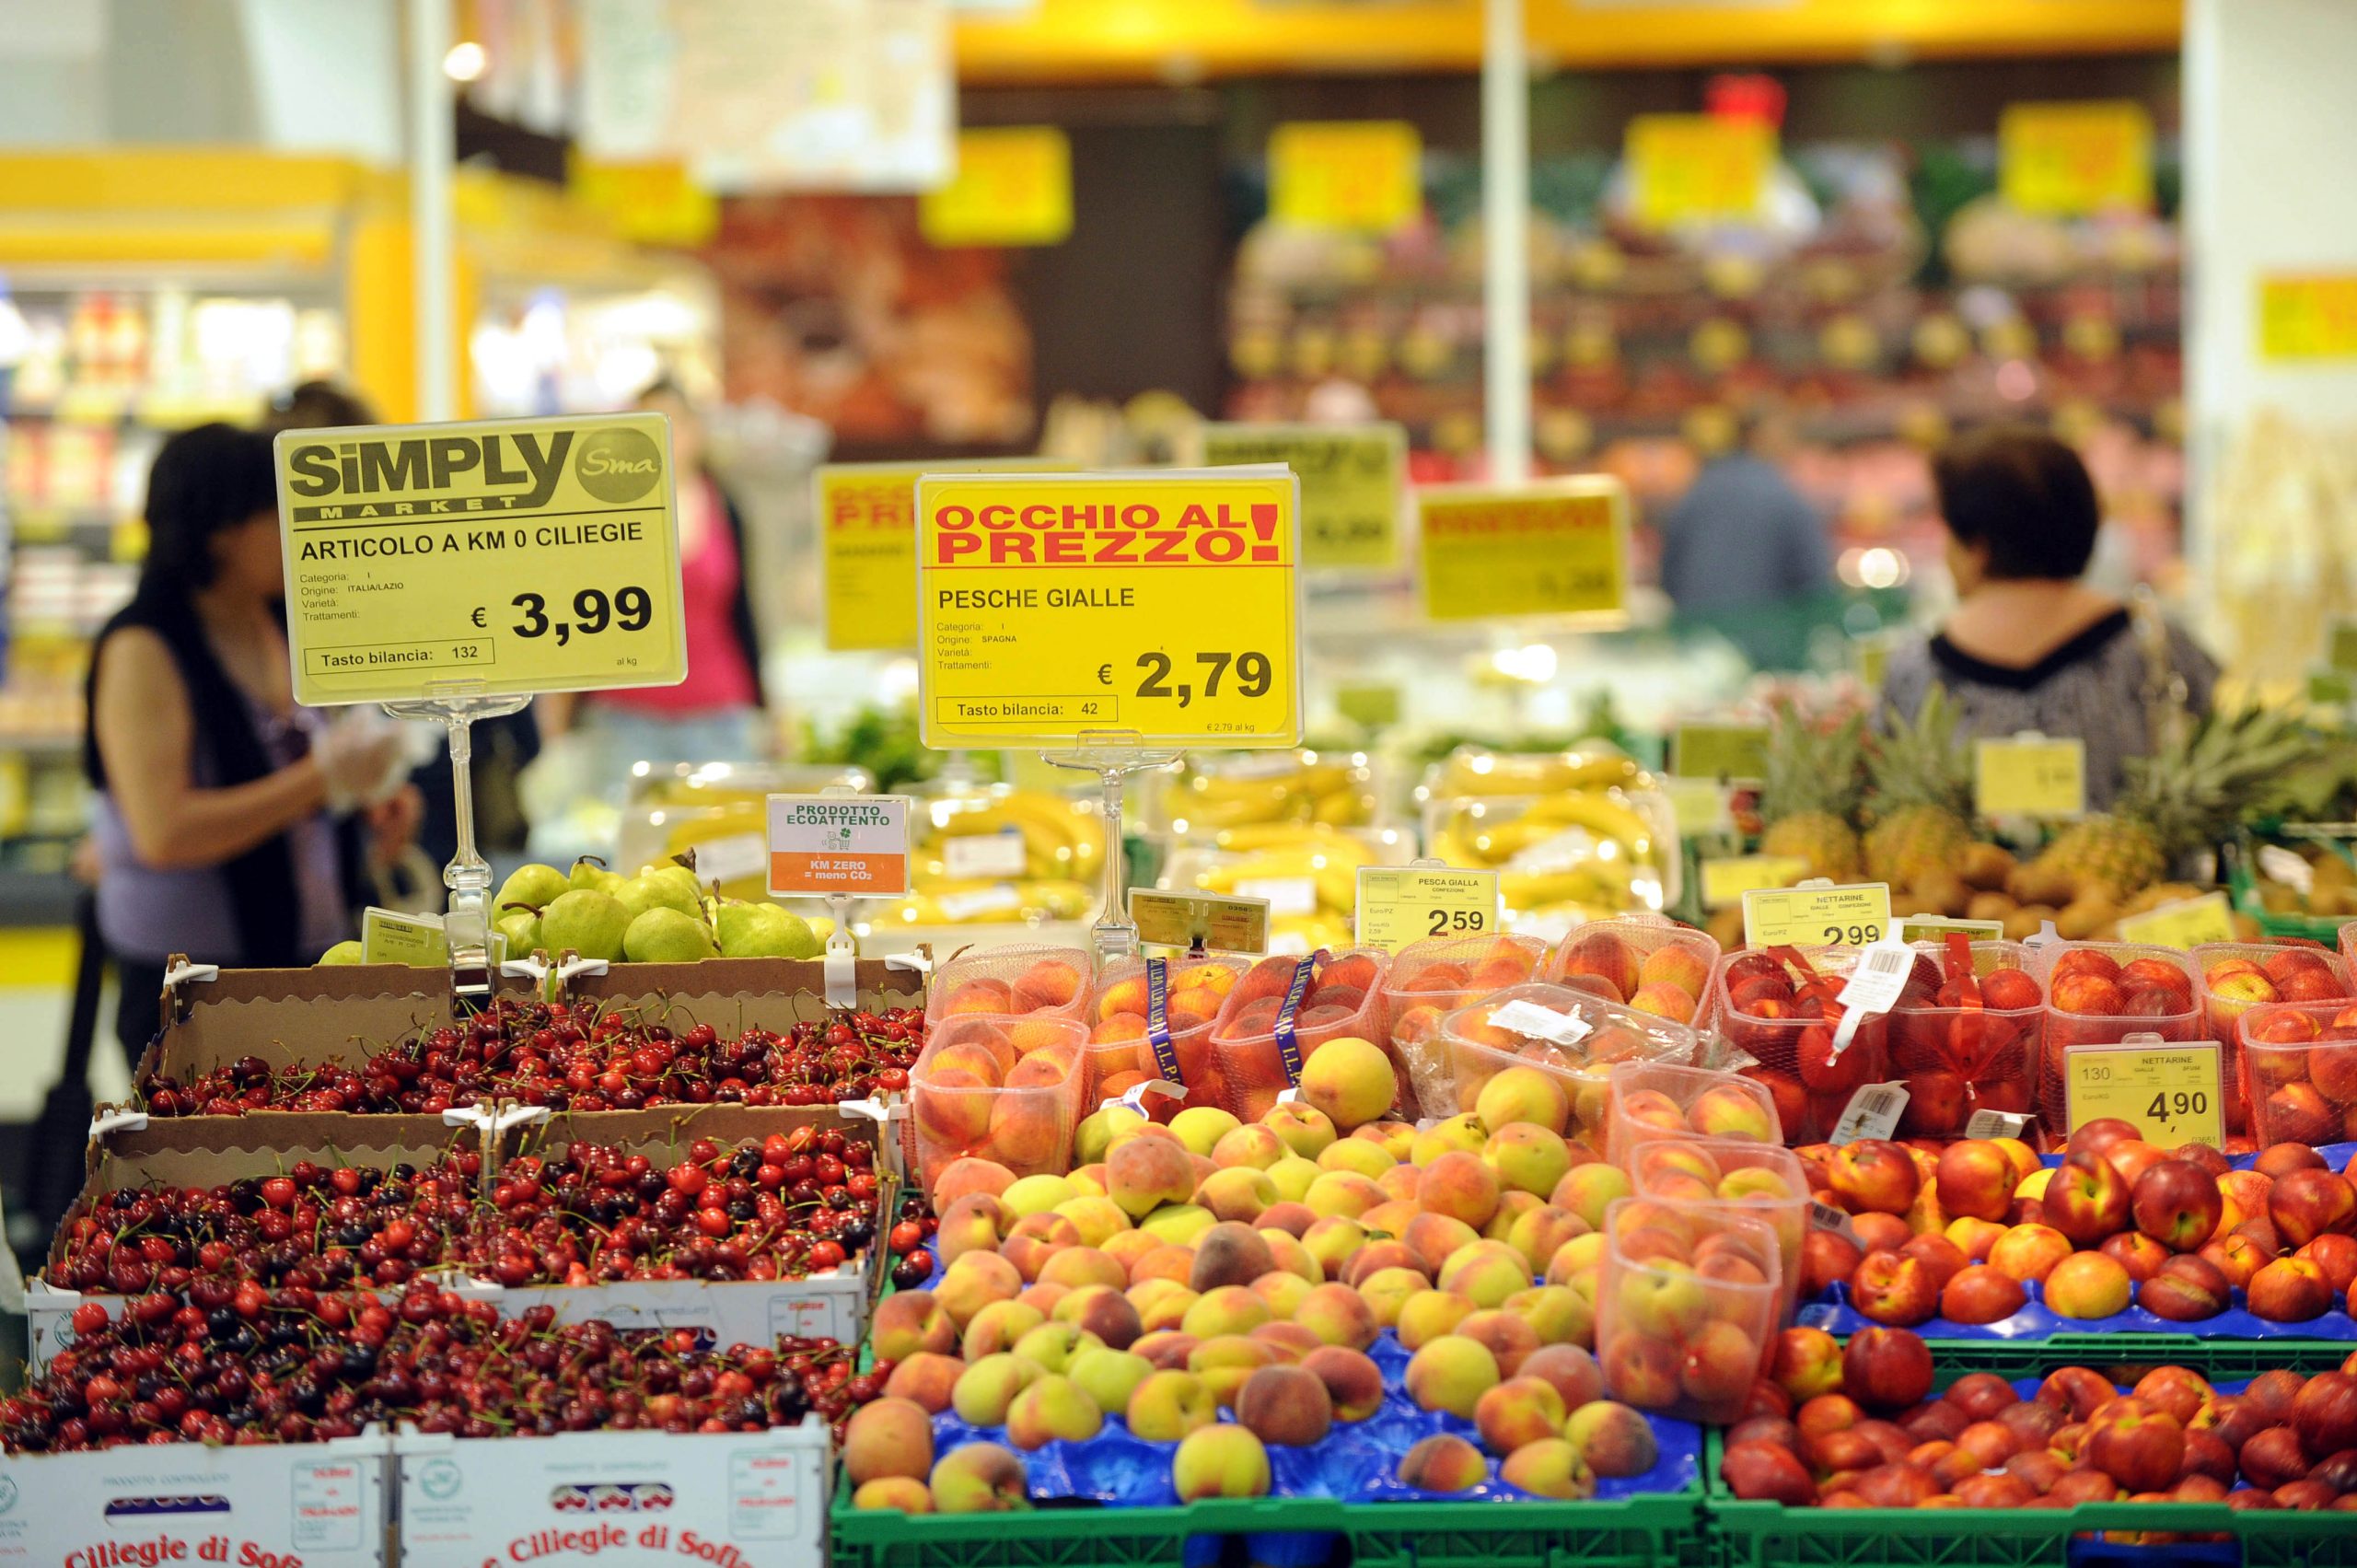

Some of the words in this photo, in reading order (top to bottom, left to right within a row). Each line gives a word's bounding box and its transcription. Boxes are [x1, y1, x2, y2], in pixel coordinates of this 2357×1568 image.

[581, 447, 658, 477] Sma
[319, 494, 517, 520] MARKET
[935, 504, 1160, 530] OCCHIO
[1176, 504, 1248, 529] AL
[300, 534, 434, 561] ARTICOLO
[442, 532, 459, 552] A
[468, 529, 506, 552] KM
[535, 522, 644, 547] CILIEGIE
[299, 574, 350, 584] Categoria:
[300, 587, 339, 597] Origine:
[347, 582, 404, 594] ITALIA/LAZIO
[301, 598, 340, 609] Varietà:
[938, 588, 1039, 610] PESCHE
[1046, 587, 1135, 609] GIALLE
[303, 610, 360, 622] Trattamenti:
[470, 607, 488, 629] €
[510, 586, 654, 646] 3,99
[936, 621, 984, 633] Categoria:
[936, 634, 972, 645] Origine:
[321, 653, 365, 668] Tasto
[368, 649, 434, 666] bilancia:
[451, 645, 479, 659] 132
[937, 647, 972, 656] Varietà:
[616, 656, 624, 665] al
[625, 656, 638, 668] kg
[937, 660, 993, 670] Trattamenti:
[1097, 663, 1113, 685] €
[1135, 650, 1272, 709] 2,79
[957, 703, 997, 716] Tasto
[1002, 702, 1064, 715] bilancia:
[1081, 702, 1098, 714] 42
[1213, 723, 1233, 733] 2,79
[1235, 723, 1243, 732] al
[1244, 723, 1255, 734] kg
[795, 805, 880, 816] PRODOTTO
[786, 815, 890, 826] ECOATTENTO
[810, 860, 830, 870] KM
[833, 860, 866, 870] ZERO
[816, 872, 847, 880] meno
[1418, 878, 1446, 887] PESCA
[1817, 894, 1865, 904] NETTARINE
[2142, 1056, 2193, 1064] NETTARINE
[2082, 1067, 2111, 1081] 130
[508, 1522, 627, 1562] Ciliegie
[637, 1525, 668, 1551] di
[197, 1535, 229, 1562] di
